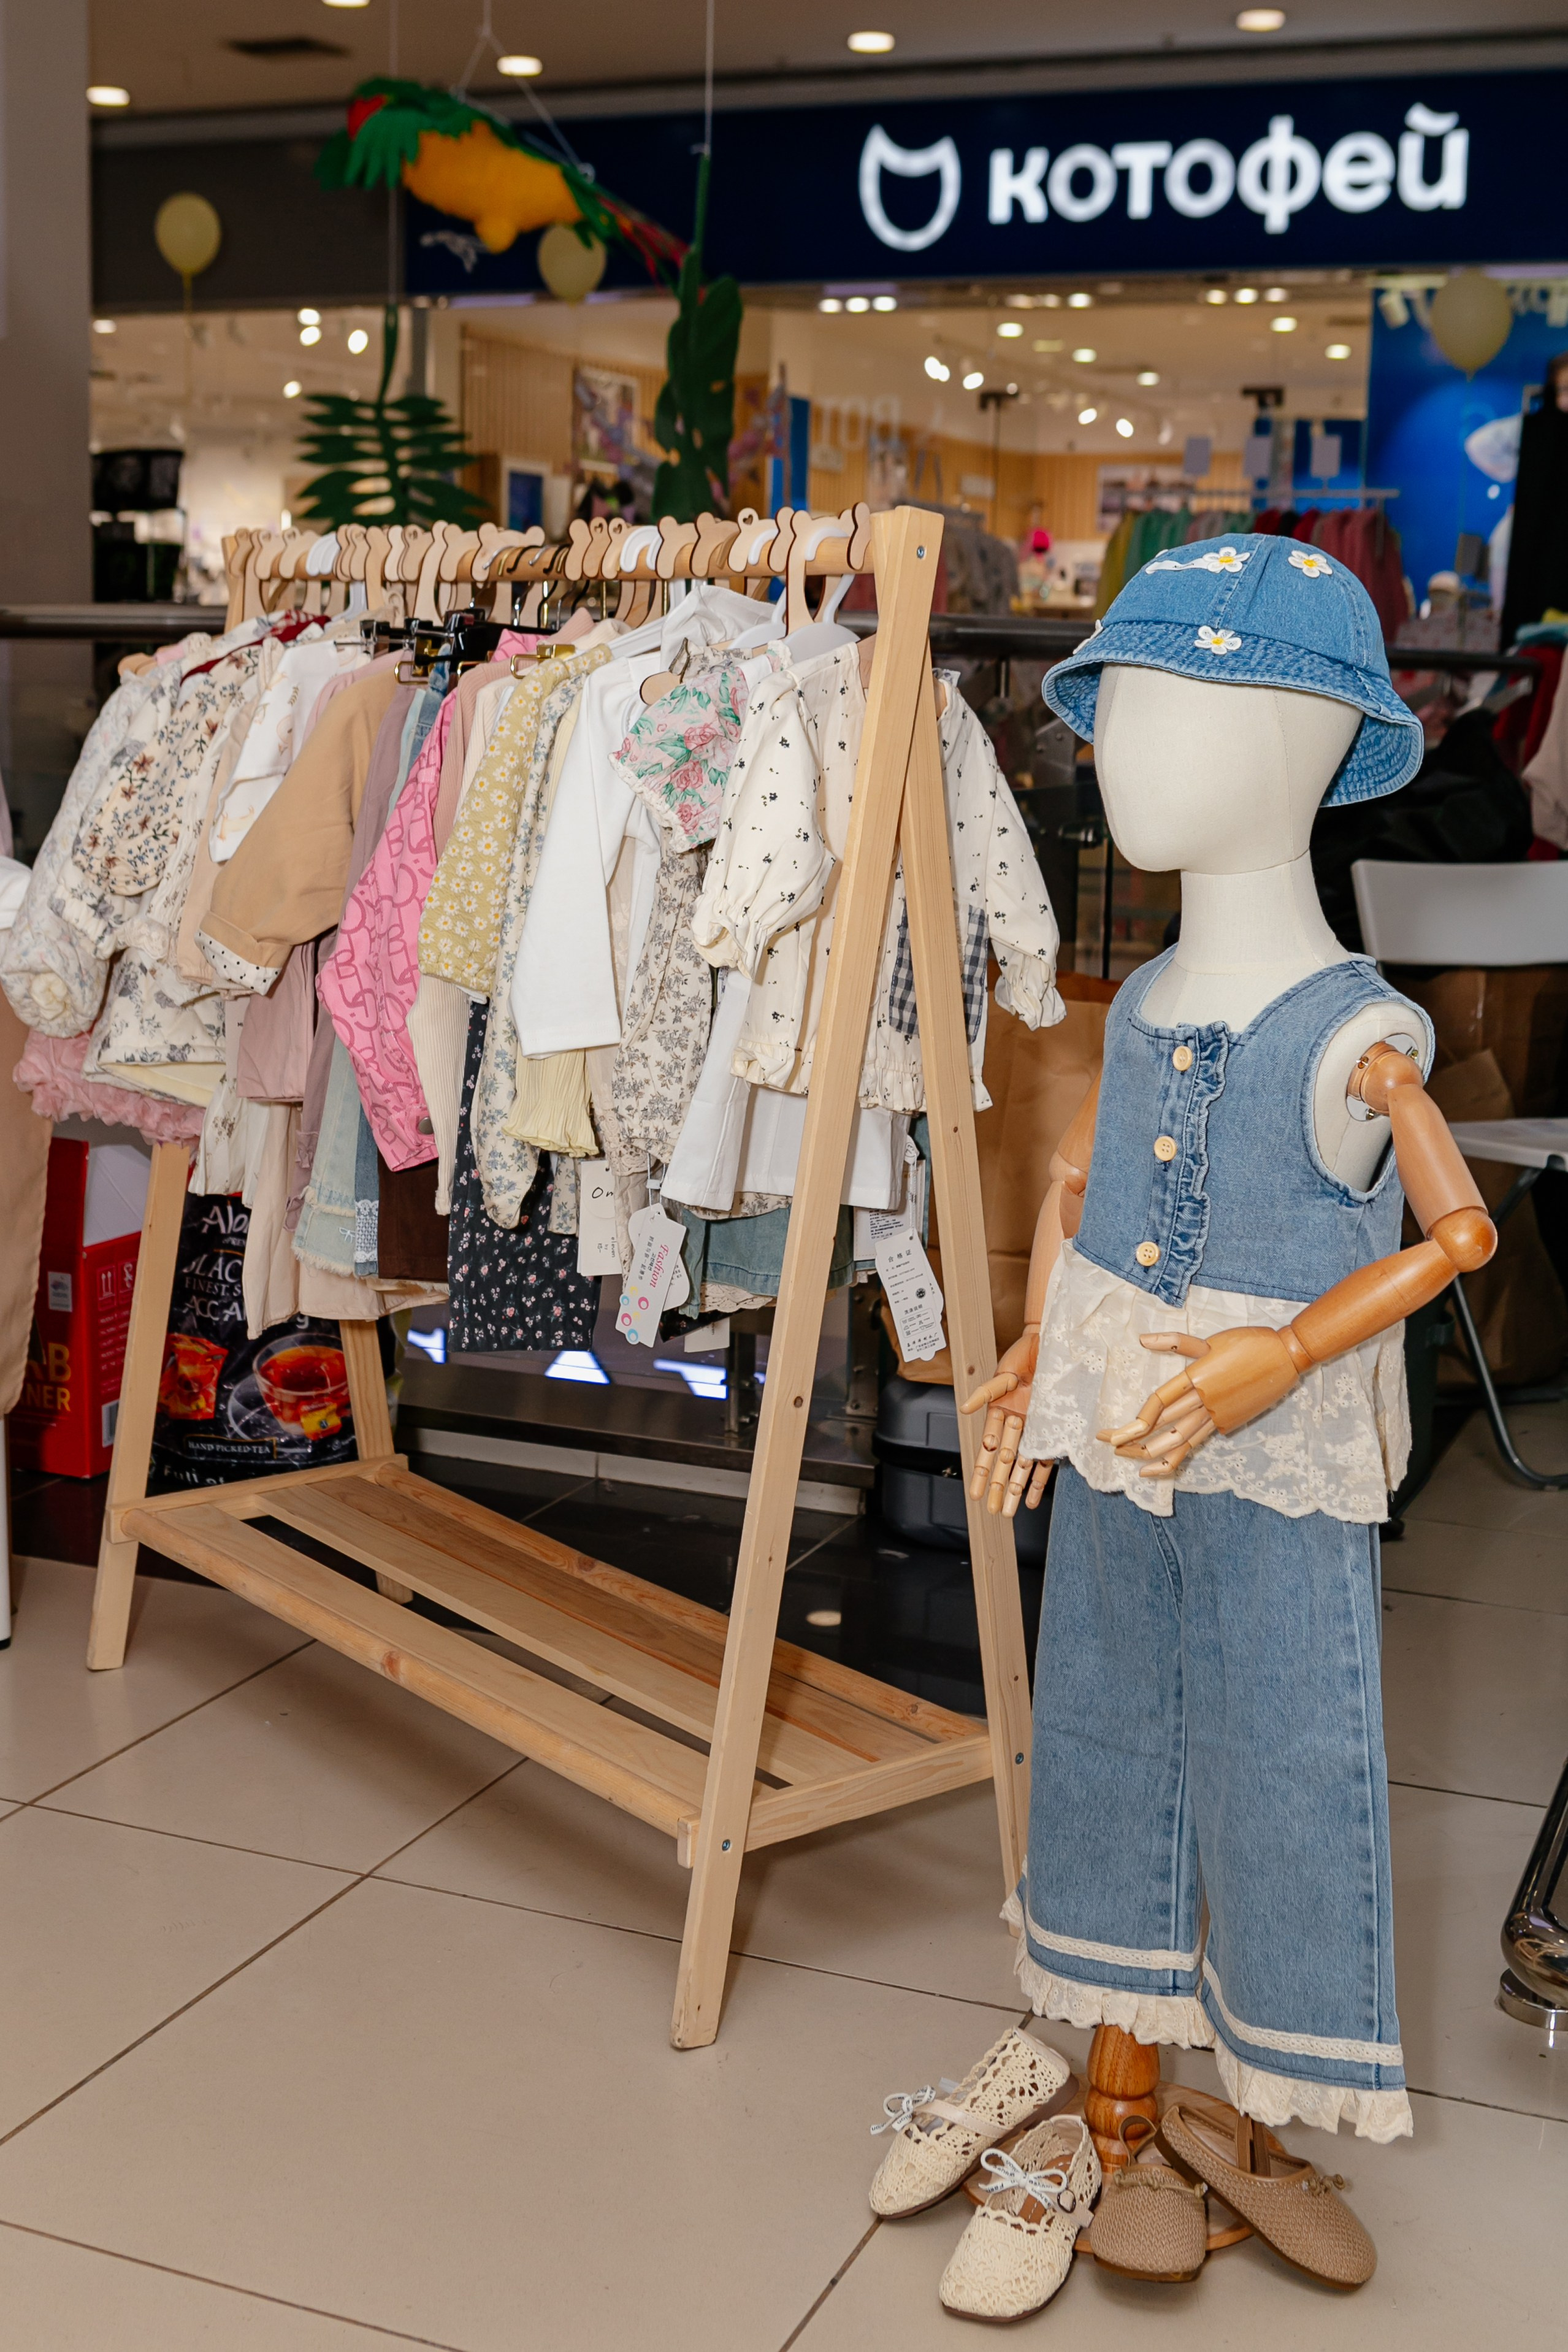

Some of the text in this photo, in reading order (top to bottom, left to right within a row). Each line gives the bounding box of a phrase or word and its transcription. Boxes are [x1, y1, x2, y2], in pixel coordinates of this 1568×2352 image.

[202, 1205, 248, 1234] Alo
[649, 1244, 669, 1287] Fashion
[188, 1441, 215, 1451] HAND
[216, 1444, 251, 1453] PICKED
